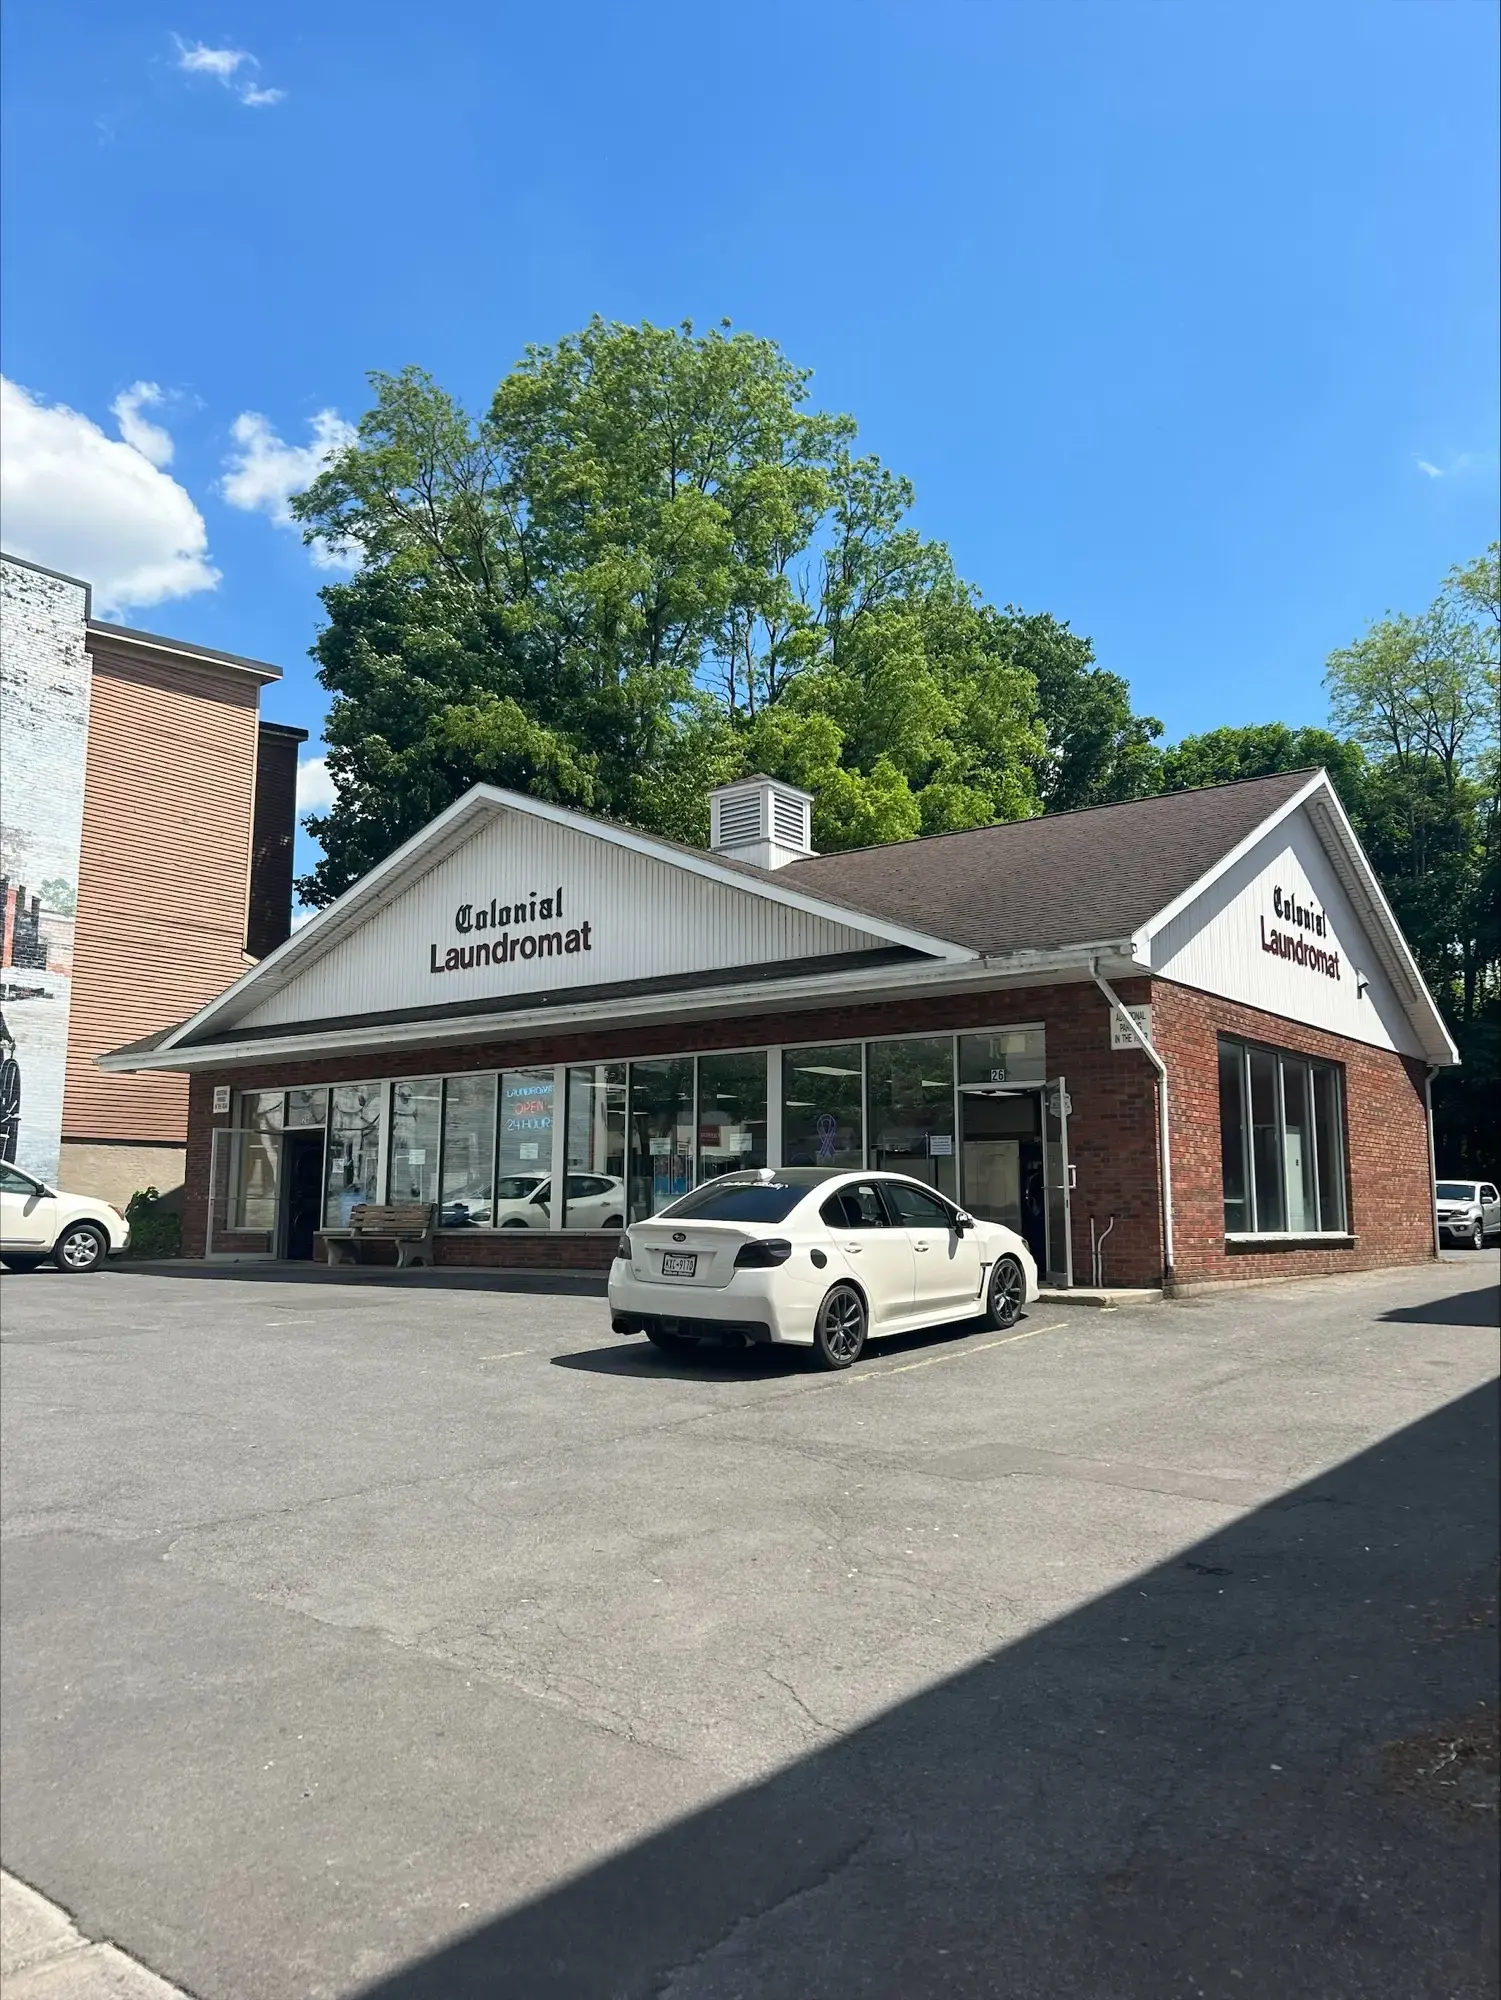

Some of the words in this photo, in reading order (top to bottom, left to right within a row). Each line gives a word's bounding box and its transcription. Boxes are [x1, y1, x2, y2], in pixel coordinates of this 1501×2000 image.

[455, 886, 563, 934] Colonial
[1273, 885, 1327, 939] Colonial
[430, 921, 592, 974] Laundromat
[1260, 915, 1340, 981] Laundromat
[1122, 1033, 1132, 1042] THE
[992, 1070, 1004, 1081] 26
[514, 1101, 544, 1115] OPEN
[507, 1118, 520, 1131] 24
